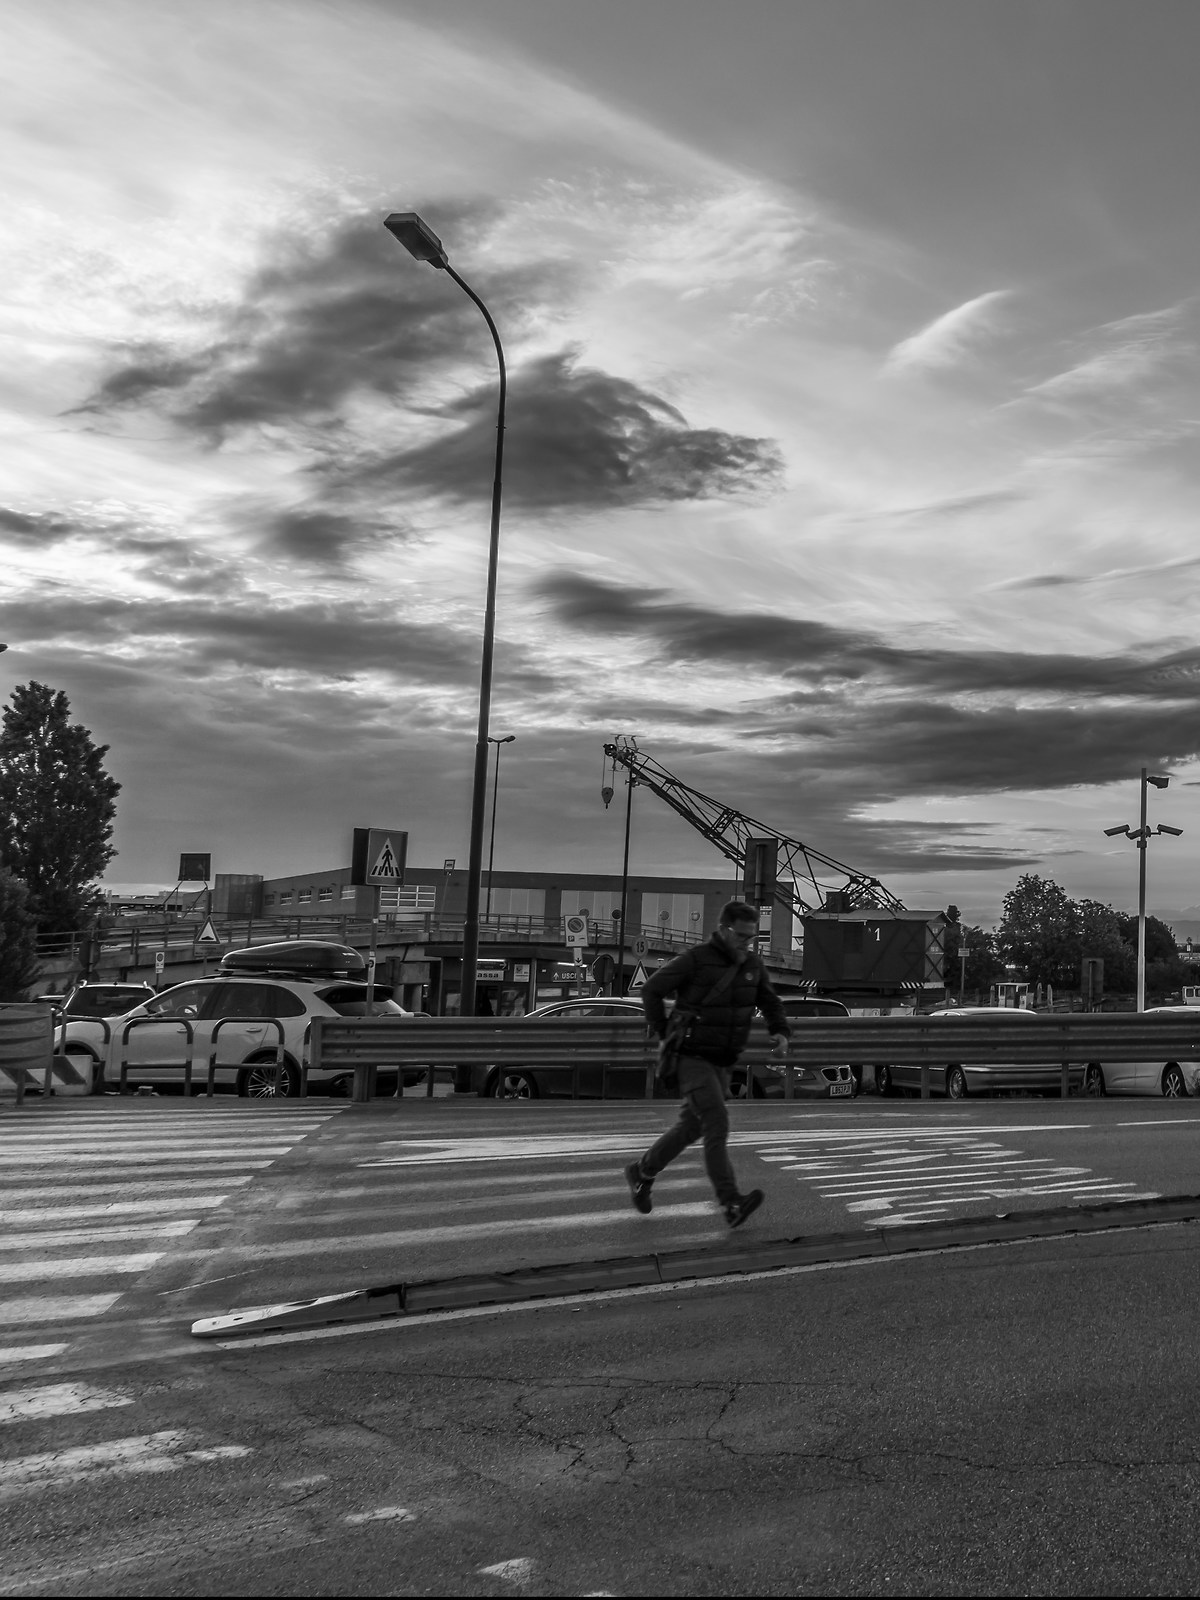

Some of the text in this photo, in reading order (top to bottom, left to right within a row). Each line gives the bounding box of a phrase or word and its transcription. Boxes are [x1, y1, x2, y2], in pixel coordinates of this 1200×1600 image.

[874, 927, 881, 941] 1
[636, 941, 645, 953] 15
[561, 972, 584, 980] USCIA
